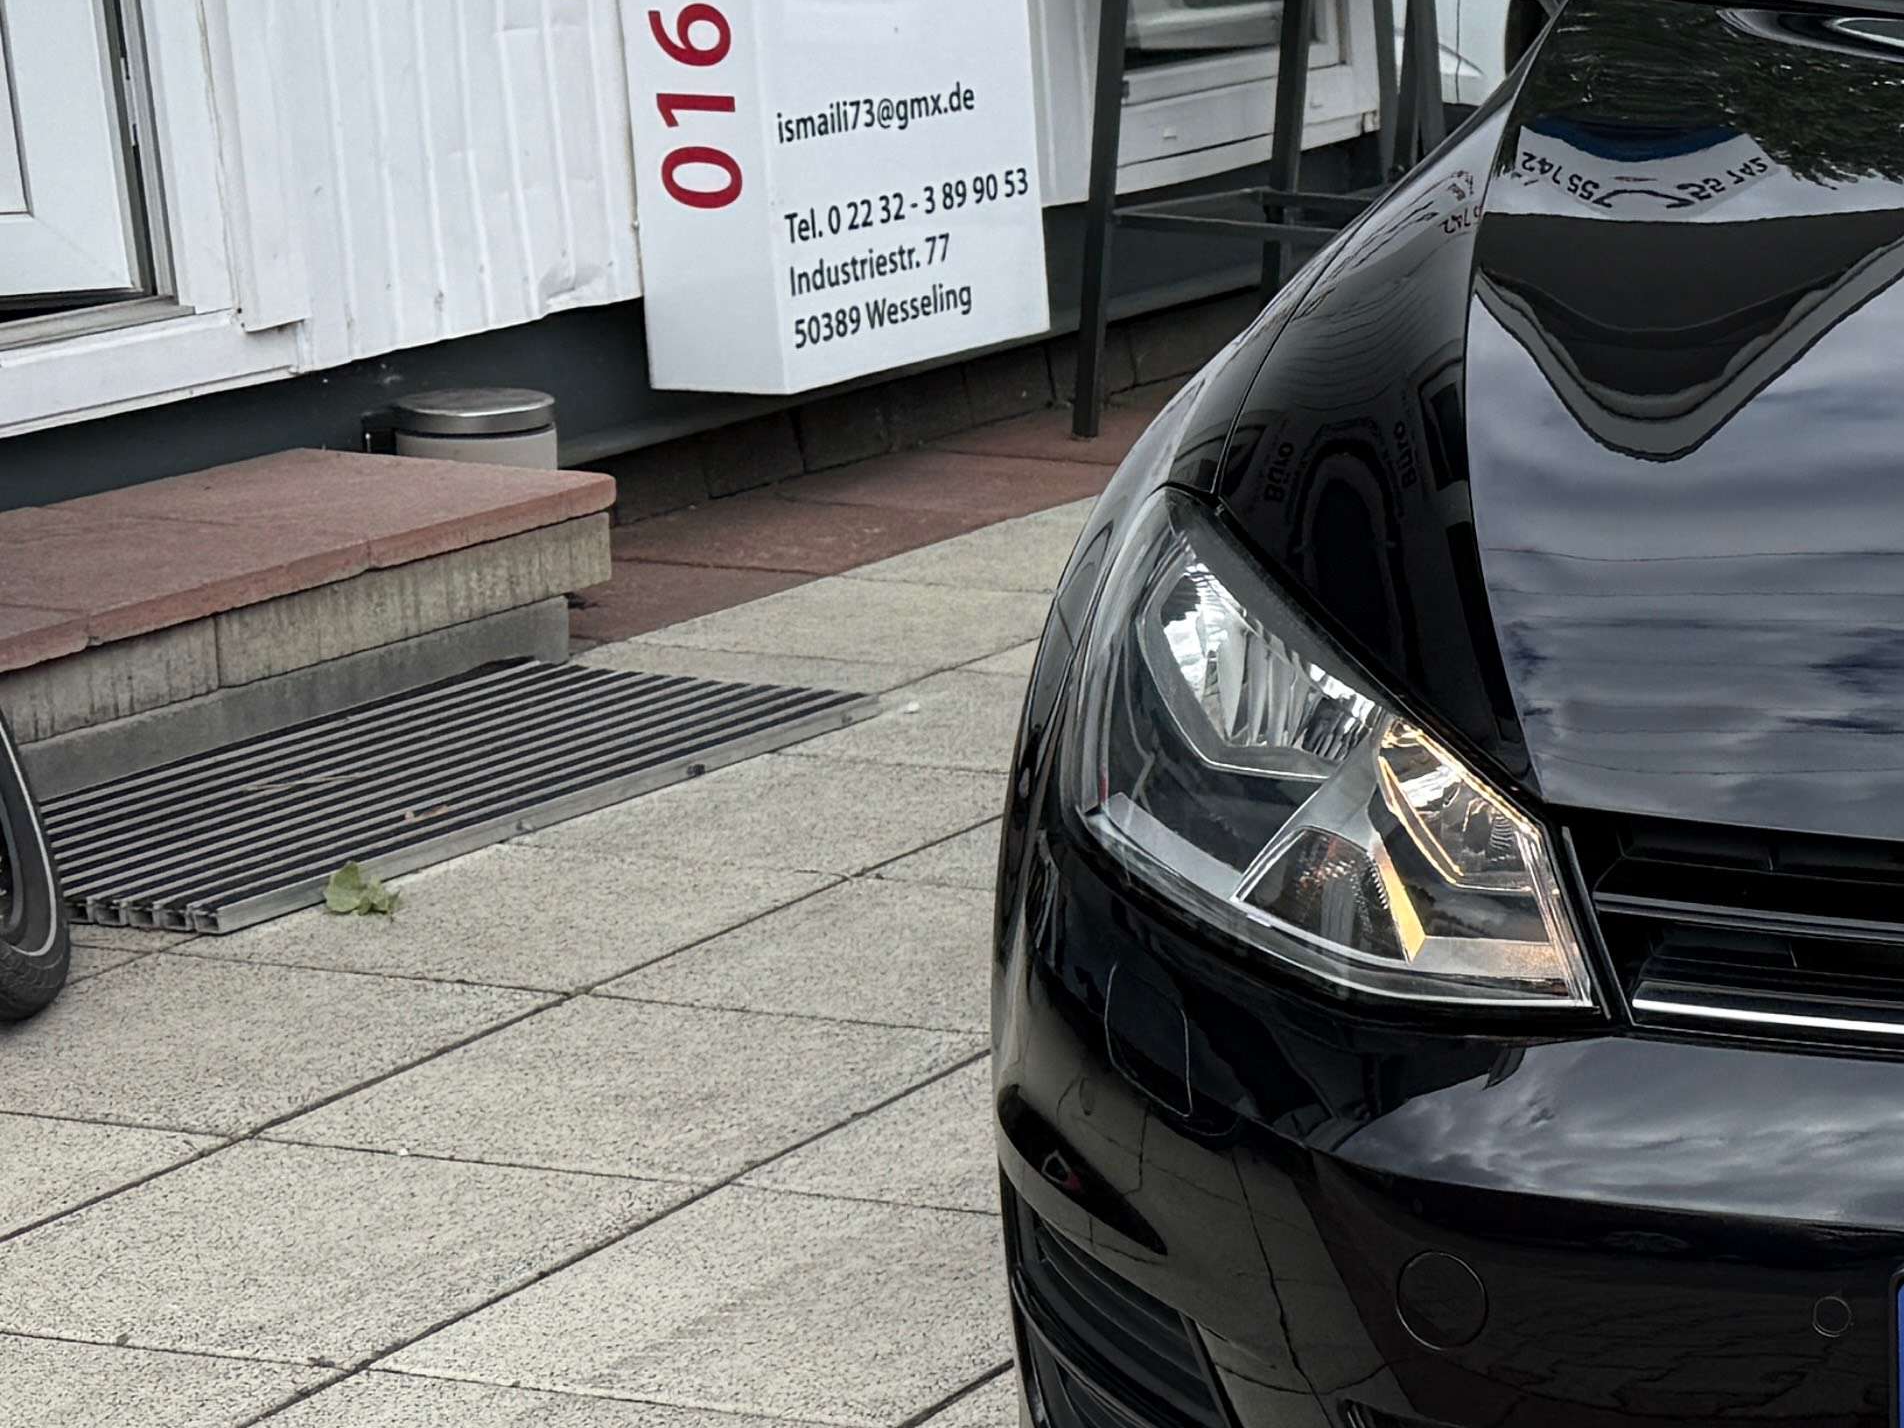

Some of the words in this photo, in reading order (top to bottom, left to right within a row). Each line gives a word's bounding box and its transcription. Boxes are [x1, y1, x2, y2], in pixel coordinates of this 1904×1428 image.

[776, 81, 976, 145] ismaili73@gmx.de
[784, 207, 824, 244] Tel.
[827, 205, 842, 236] 0
[846, 199, 874, 231] 22
[879, 192, 906, 224] 32
[923, 185, 937, 215] 3
[942, 179, 967, 211] 89
[972, 173, 999, 205] 90
[1003, 167, 1029, 199] 53
[789, 245, 922, 297] Industriestr.
[924, 232, 951, 266] 77
[794, 306, 862, 349] 50389
[865, 283, 973, 330] Wesseling
